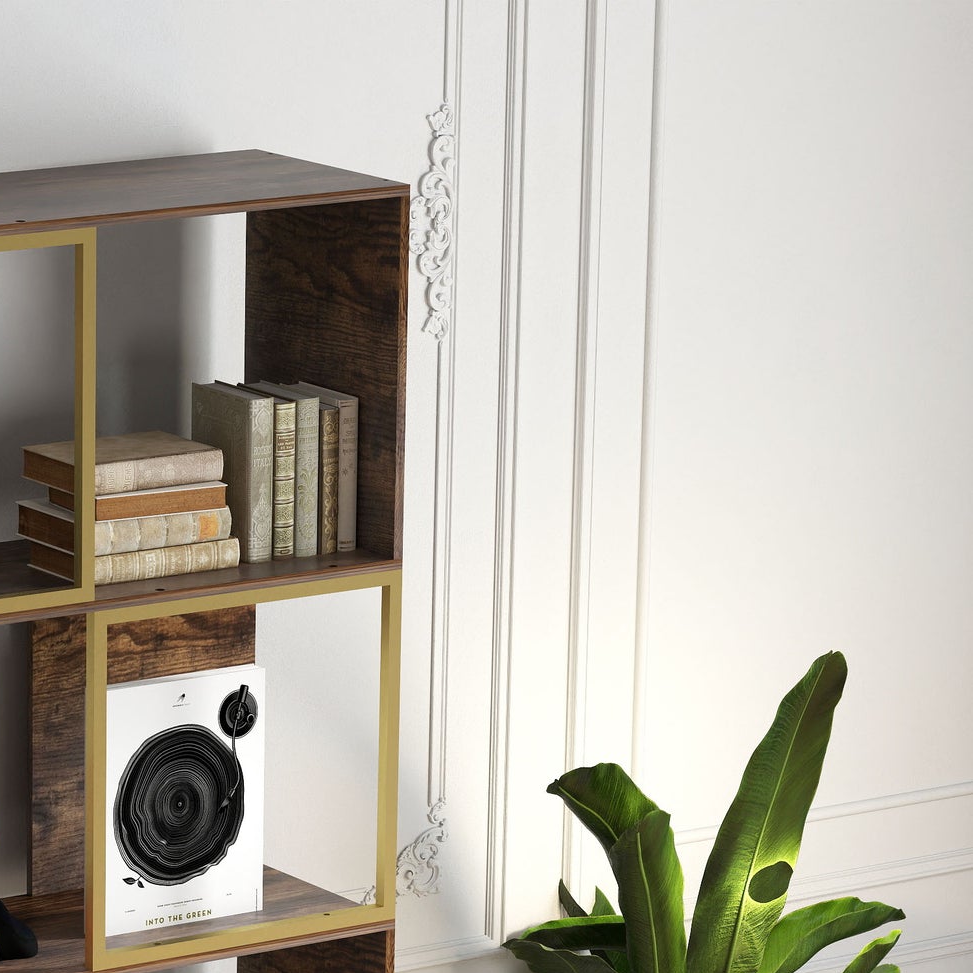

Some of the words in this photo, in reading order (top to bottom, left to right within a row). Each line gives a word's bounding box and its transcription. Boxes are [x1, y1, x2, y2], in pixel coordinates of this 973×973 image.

[145, 915, 164, 926] INTO
[168, 913, 183, 922] THE
[186, 909, 212, 919] GREEN
